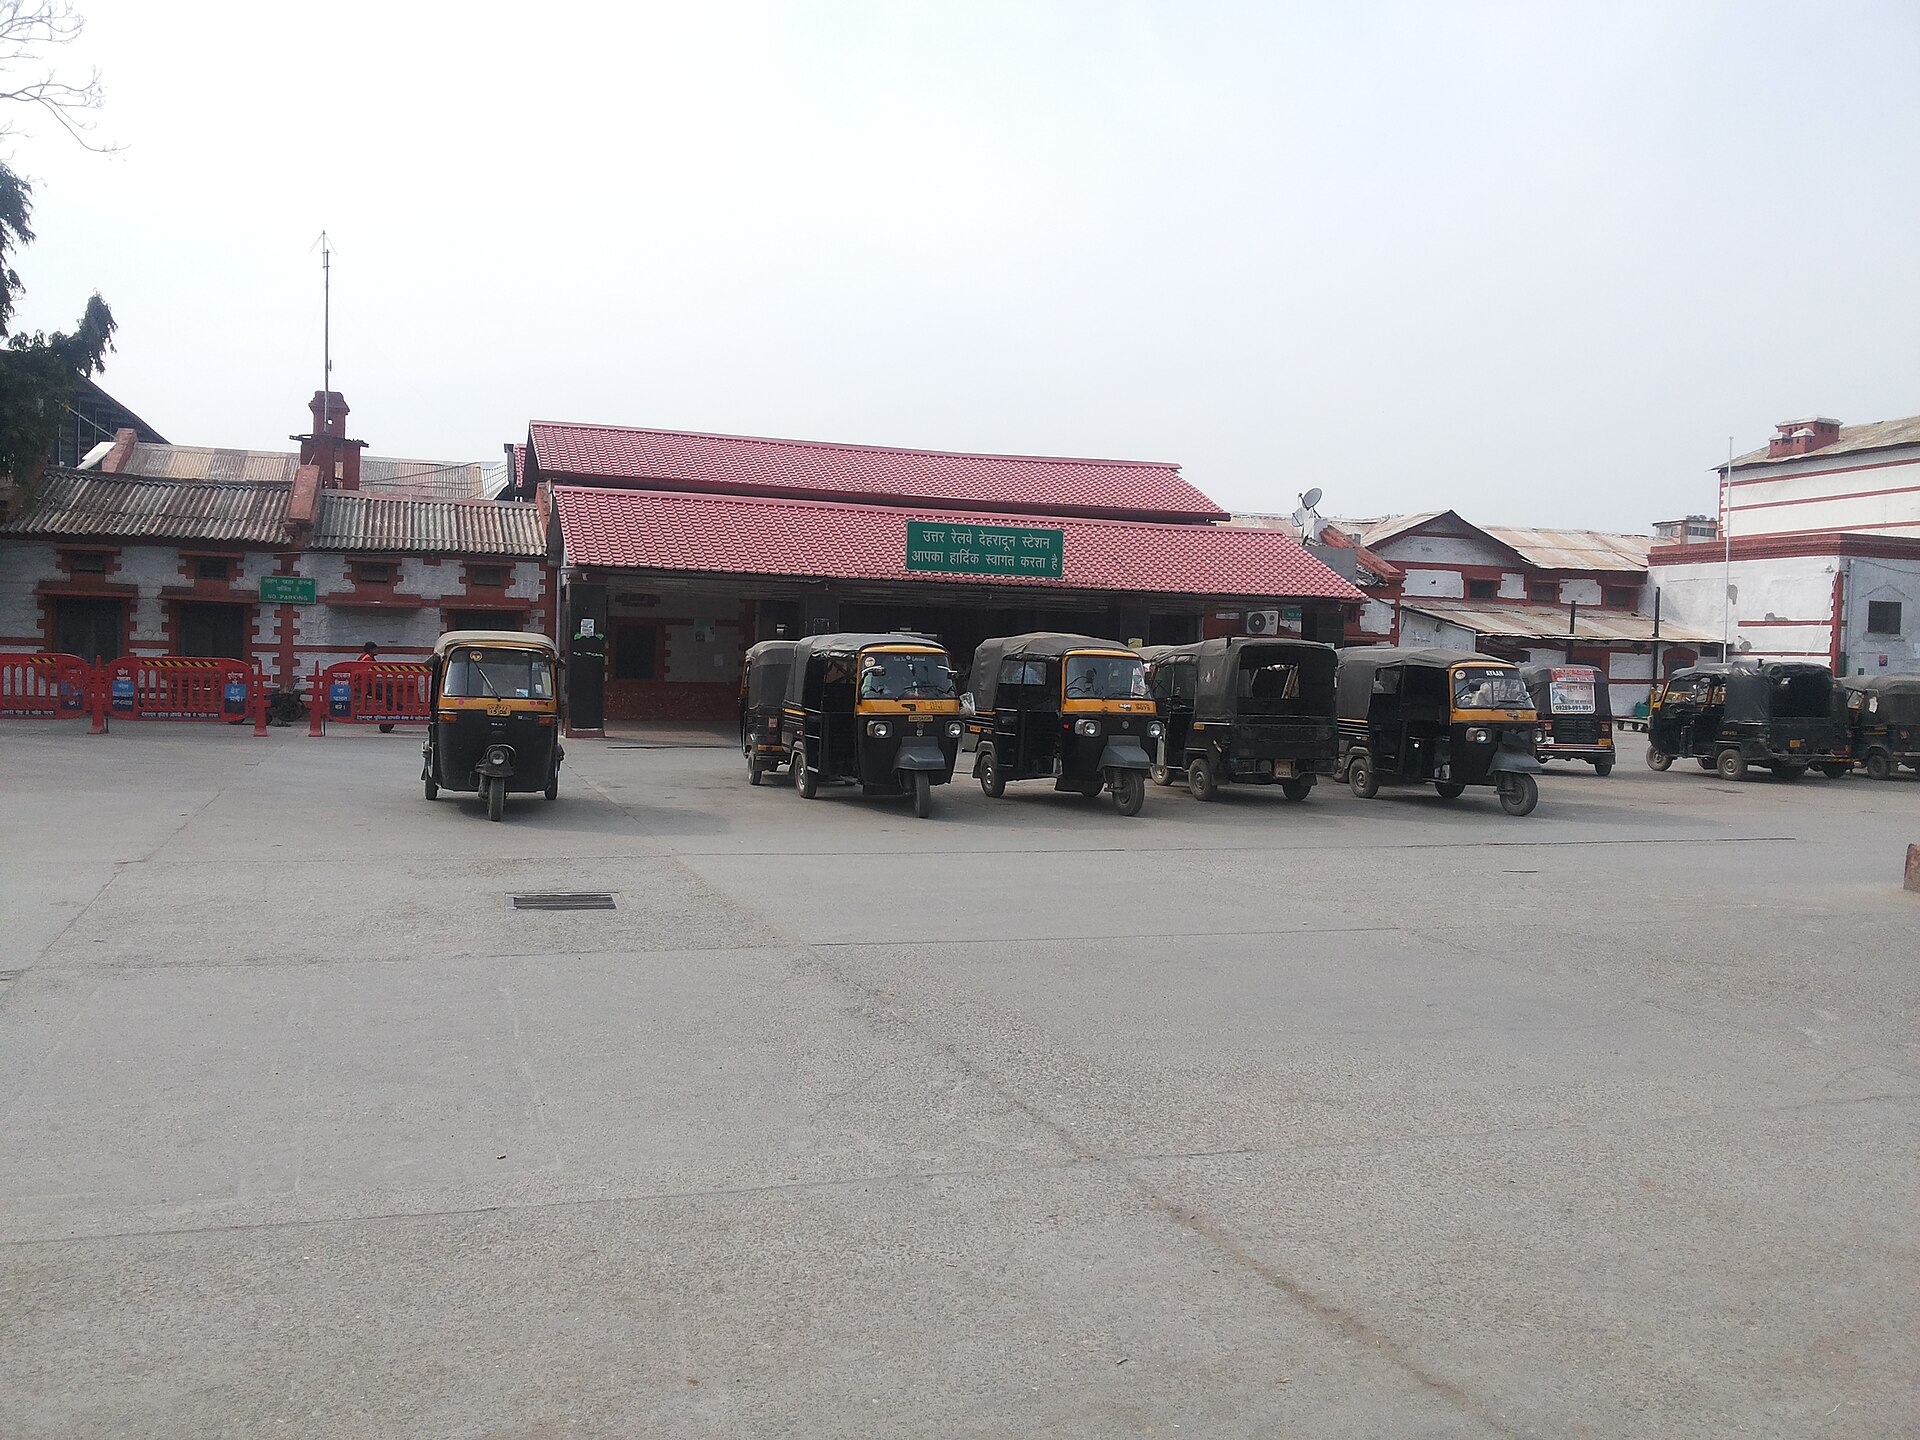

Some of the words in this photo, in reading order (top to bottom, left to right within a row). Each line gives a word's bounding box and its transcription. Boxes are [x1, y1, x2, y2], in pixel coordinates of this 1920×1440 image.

[923, 530, 945, 543] उत्तर
[951, 529, 973, 545] रेलवे
[978, 530, 1016, 551] देहरादून
[1021, 533, 1050, 549] स्टेशन
[911, 550, 944, 563] आपका
[949, 549, 980, 565] हार्दिक
[985, 554, 1015, 567] स्वागत
[1020, 556, 1046, 569] करता
[1051, 554, 1058, 570] है
